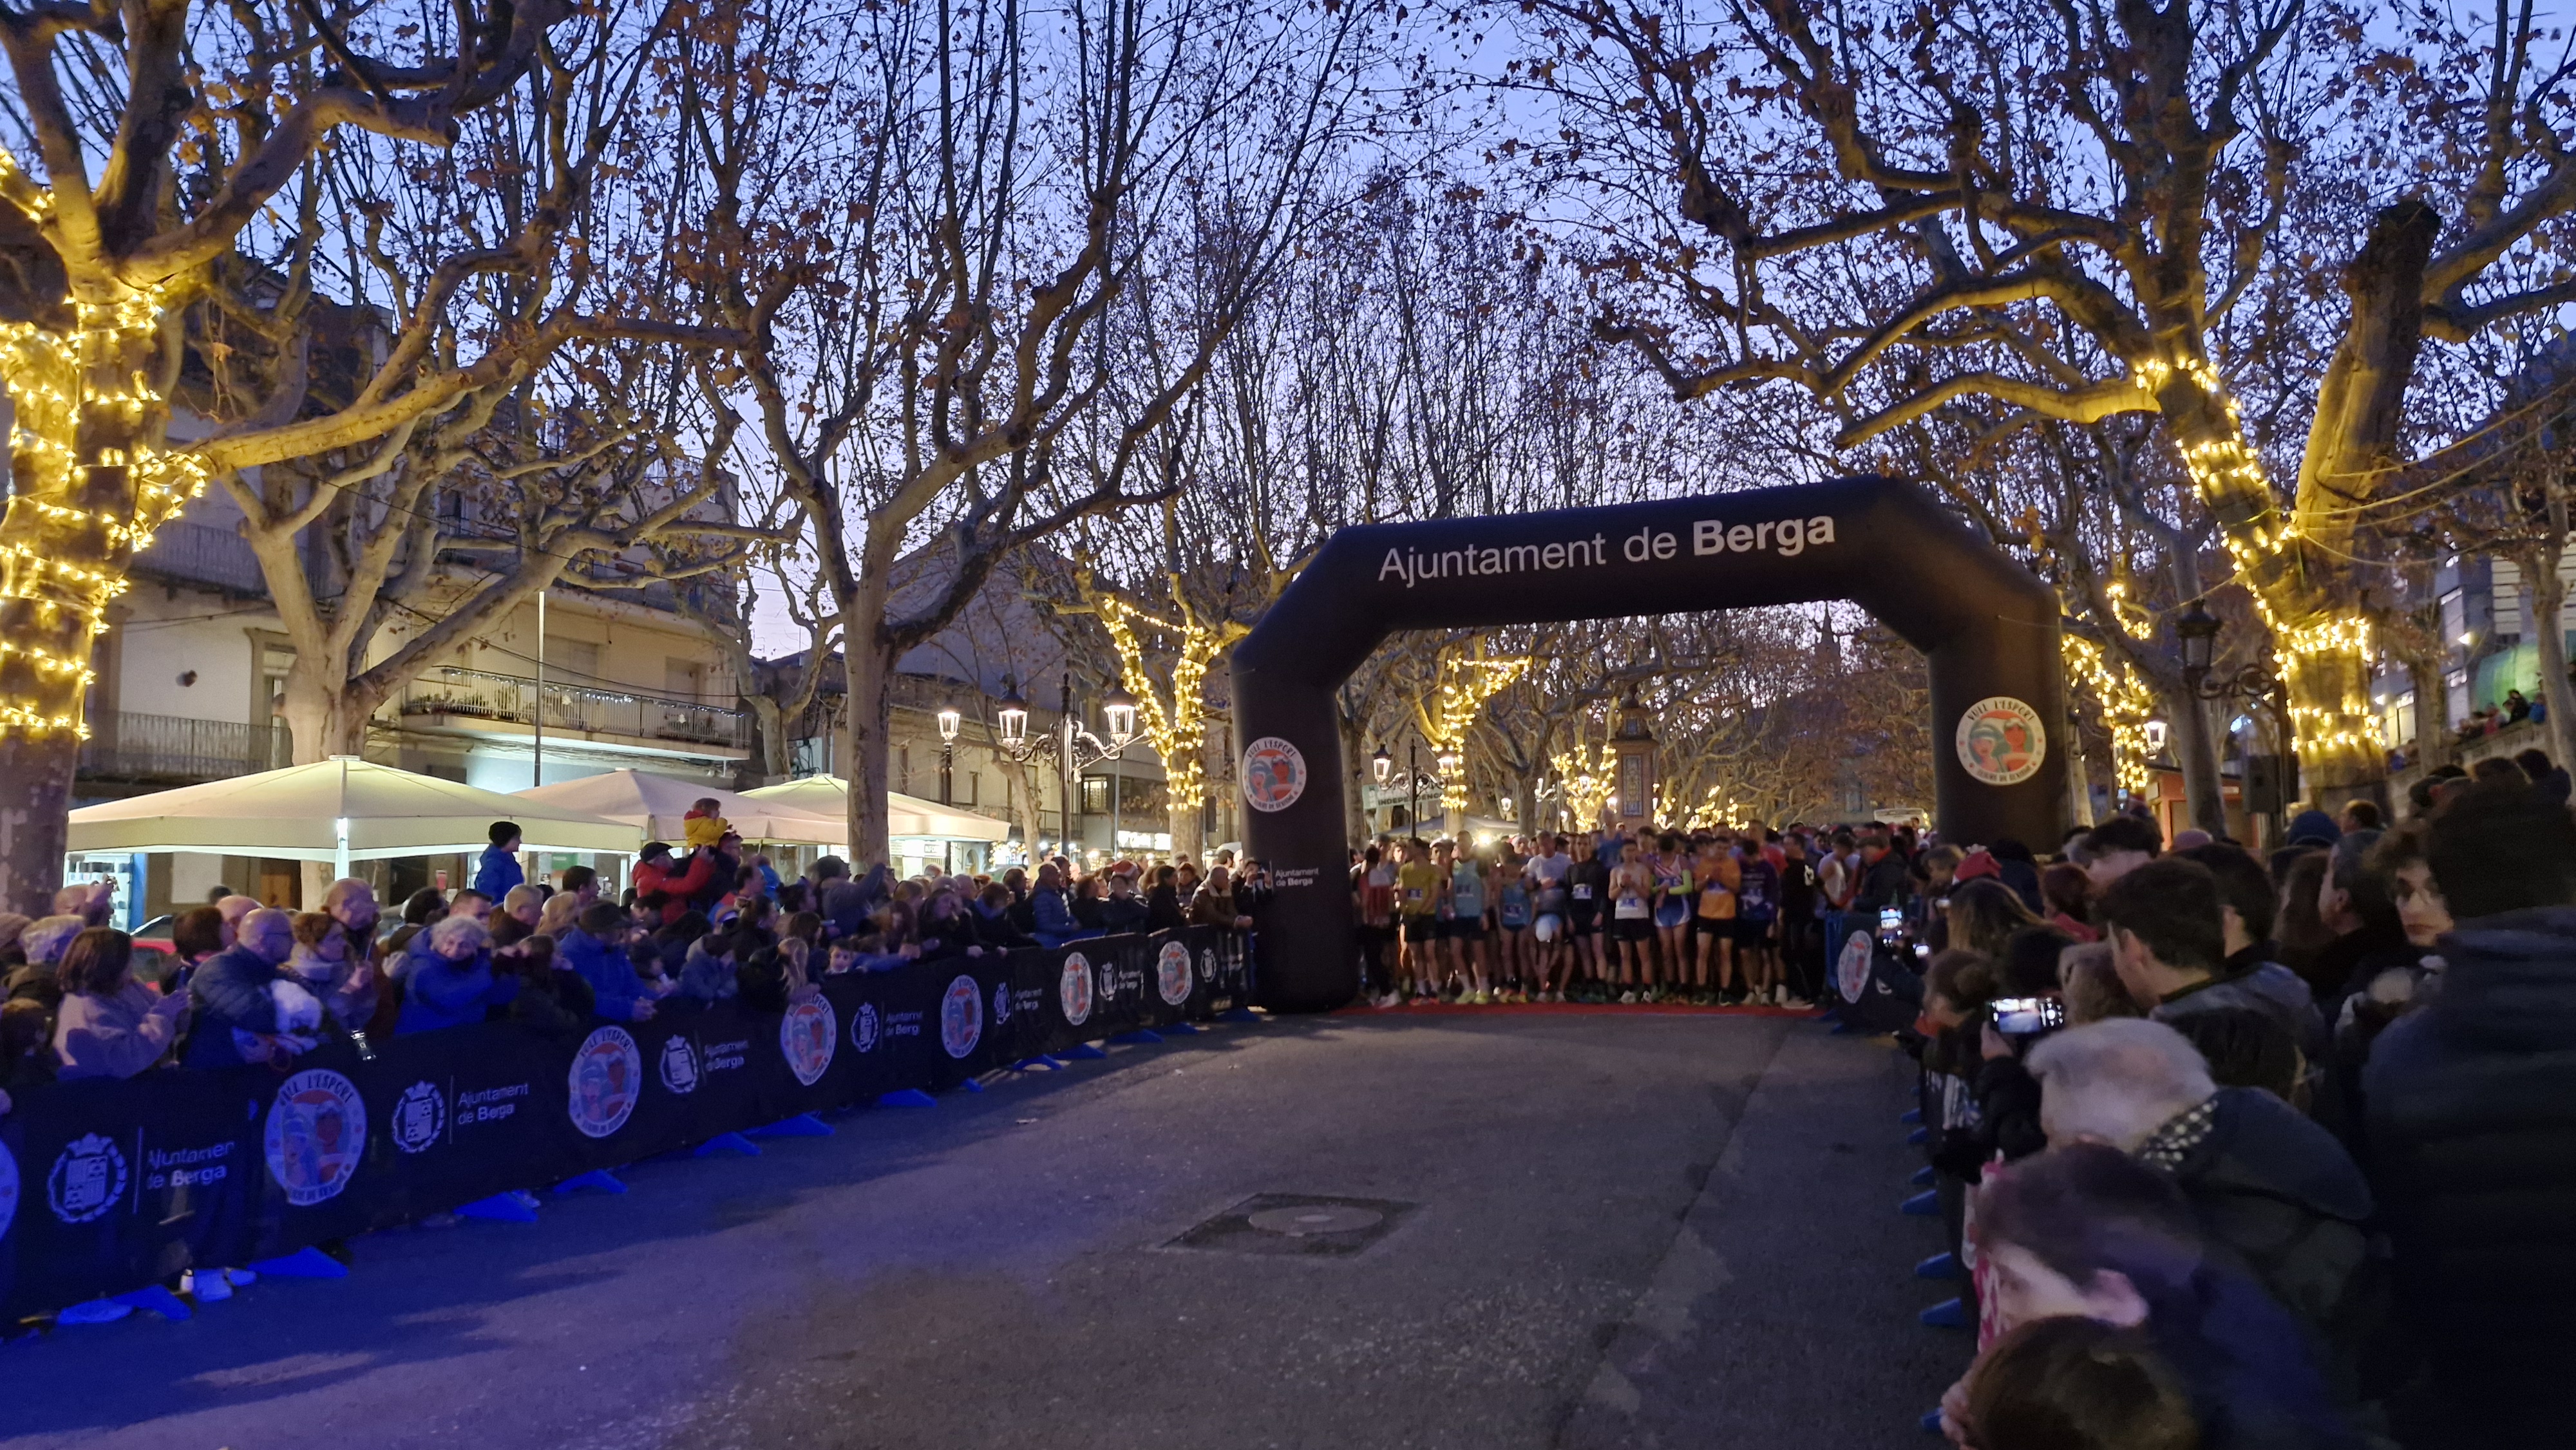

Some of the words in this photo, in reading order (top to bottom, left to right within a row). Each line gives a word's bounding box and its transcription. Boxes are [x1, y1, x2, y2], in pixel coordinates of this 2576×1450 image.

[1378, 532, 1606, 588] Ajuntament
[1624, 527, 1676, 562] de
[1693, 516, 1835, 556] Berga
[1275, 867, 1319, 879] Ajuntament
[1287, 878, 1314, 887] Berga
[458, 1082, 528, 1109] Ajuntament
[458, 1111, 474, 1125] de
[170, 1165, 227, 1186] Berga
